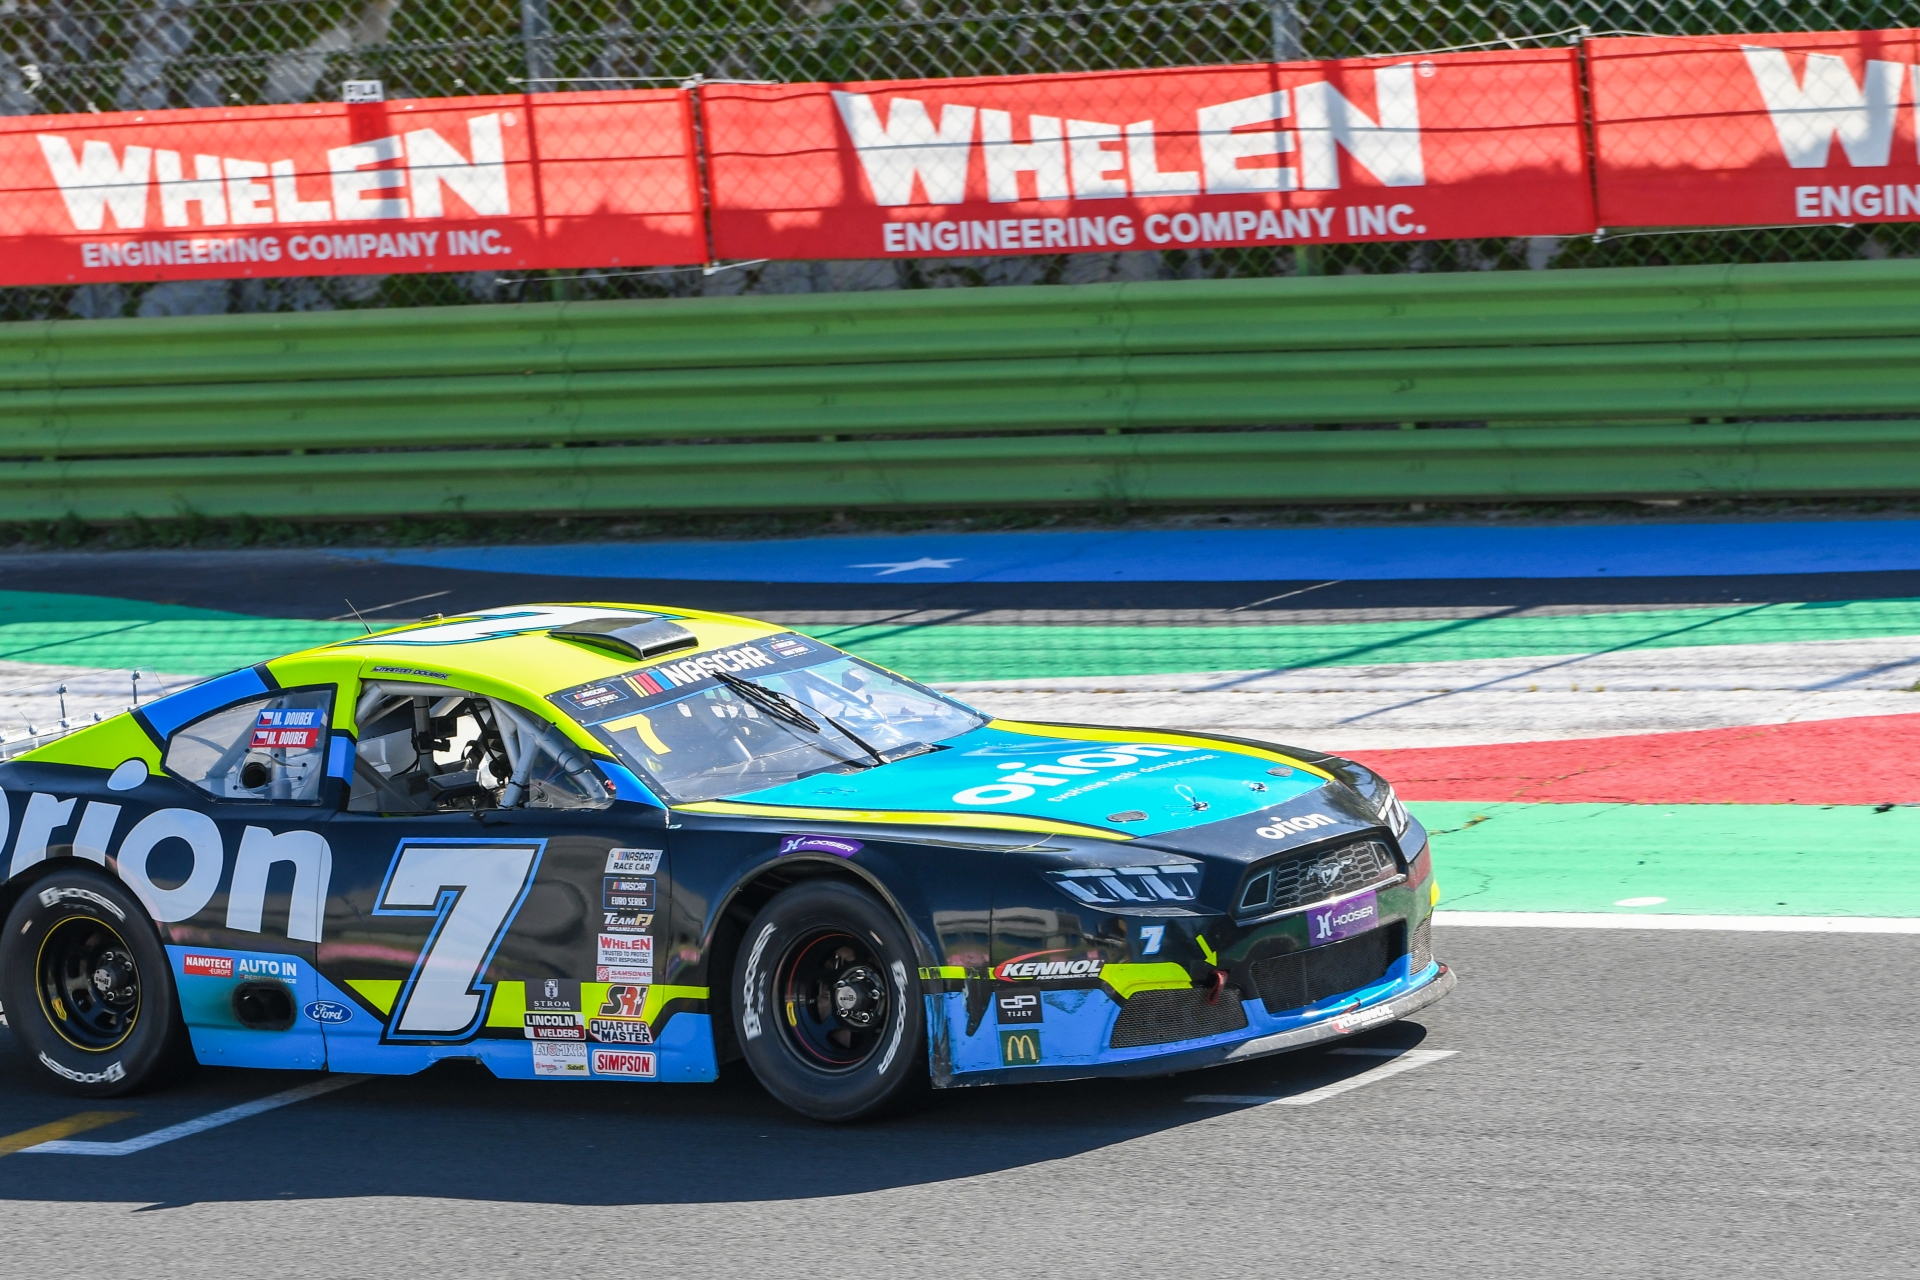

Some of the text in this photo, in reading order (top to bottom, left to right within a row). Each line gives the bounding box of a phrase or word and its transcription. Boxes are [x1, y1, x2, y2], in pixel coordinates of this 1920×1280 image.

[1741, 45, 1920, 168] W
[829, 62, 1426, 206] WHELEN
[37, 113, 509, 231] WHELEN
[883, 204, 1426, 252] ENGINEERING COMPANY INC.
[83, 229, 511, 268] ENGINEERING COMPANY INC.
[659, 647, 775, 687] NASCAR
[272, 712, 315, 726] M. DOUBEK
[267, 731, 309, 745] M. DOUBEK
[601, 714, 672, 755] 7
[952, 744, 1203, 805] orion
[1256, 813, 1338, 840] orion
[0, 759, 332, 943] rion
[802, 839, 854, 852] HOOSIER
[625, 852, 654, 862] NASCAR
[635, 863, 651, 871] CAR
[620, 882, 647, 891] NASCAR
[611, 897, 647, 907] EURO SERIES
[1332, 906, 1373, 927] HOOSIER
[375, 840, 545, 1043] 7
[600, 936, 651, 950] WHELEN
[1139, 926, 1165, 956] 7
[186, 956, 297, 977] NANOTECH AUTO IN
[1001, 960, 1101, 977] KENNOL
[244, 974, 297, 985] PERFORMANCE
[313, 1003, 343, 1020] Ford
[526, 1014, 574, 1026] LINCOLN
[538, 1028, 580, 1038] WELDERS
[591, 1020, 647, 1035] QUARTER
[601, 1030, 651, 1043] MASTER
[597, 1053, 650, 1073] SIMPSON
